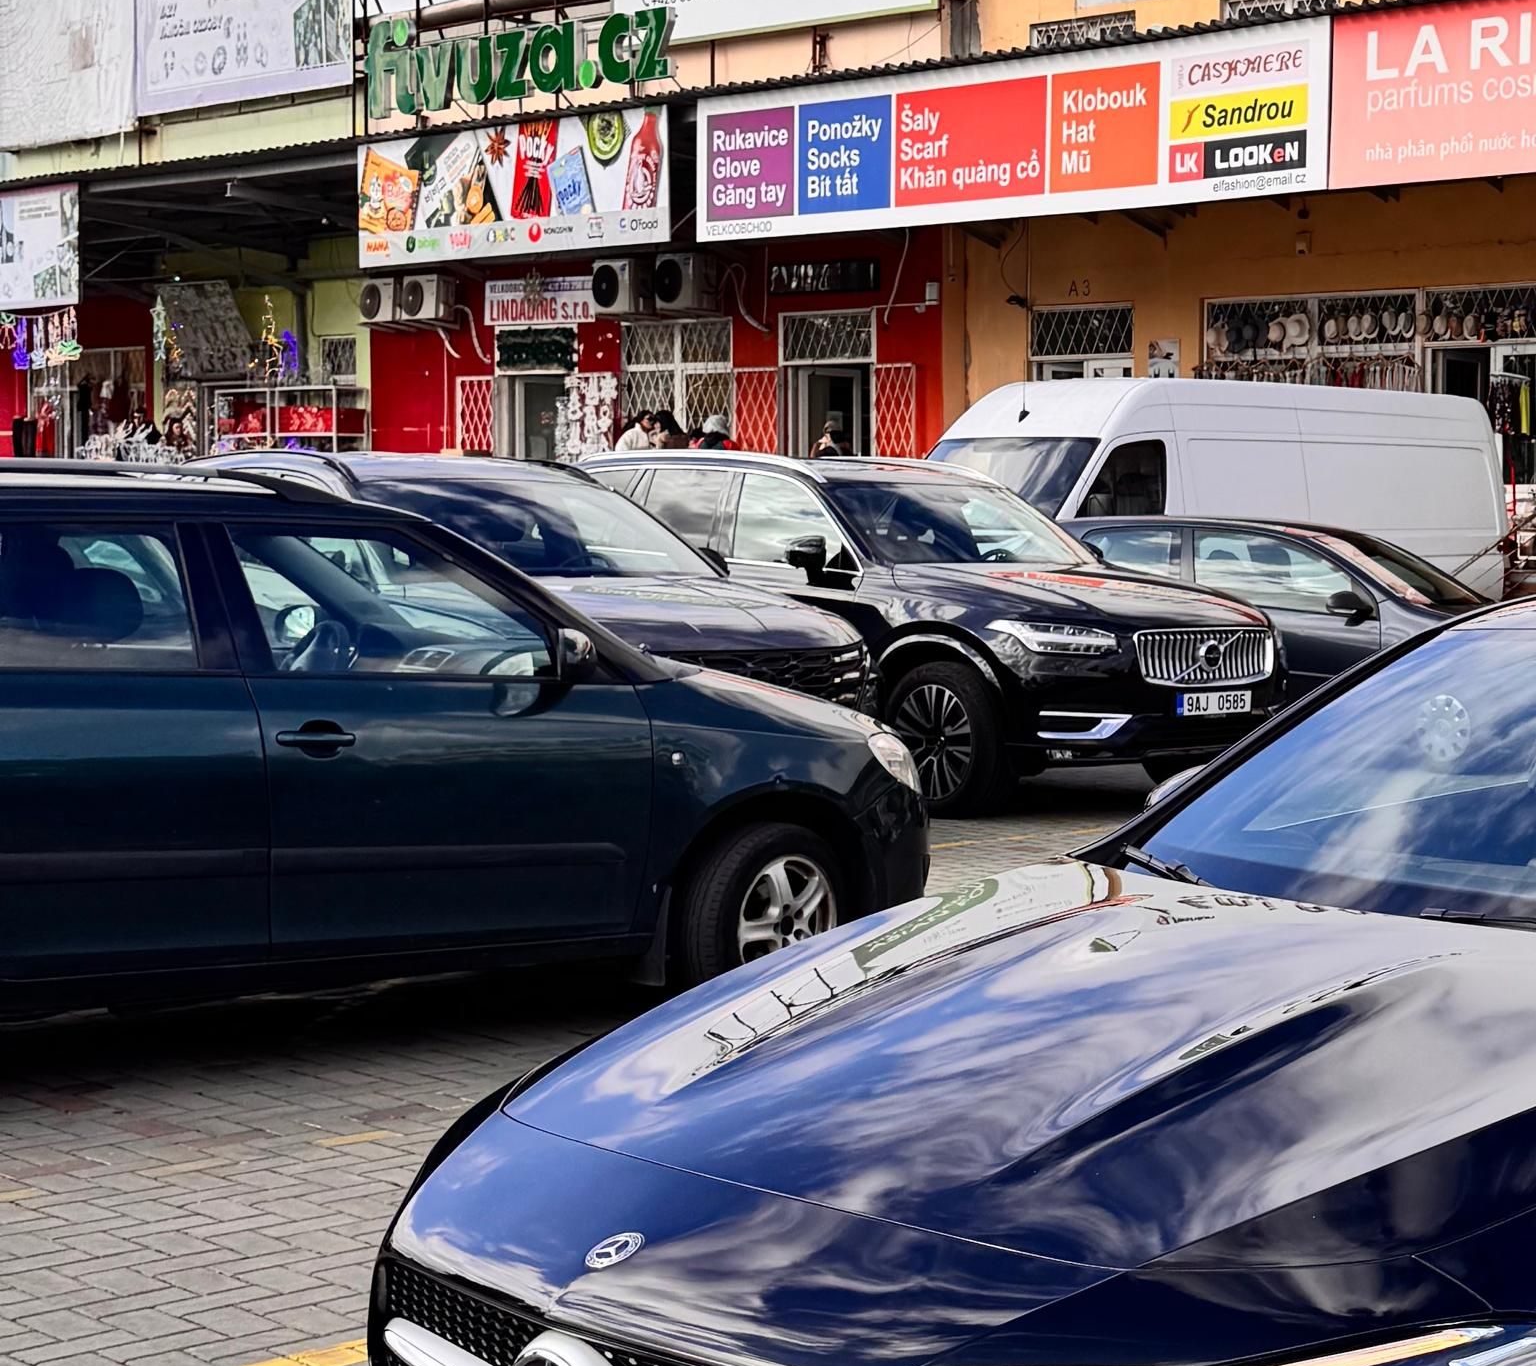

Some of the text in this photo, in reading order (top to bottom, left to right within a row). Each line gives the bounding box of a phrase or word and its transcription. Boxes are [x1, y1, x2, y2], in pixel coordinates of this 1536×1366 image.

[365, 6, 677, 120] fivuza.cz
[1365, 24, 1449, 81] LA
[1188, 49, 1302, 86] CASHMERE
[1063, 83, 1147, 115] Klobouk
[1203, 98, 1294, 128] Sandrou
[1366, 78, 1473, 119] parfums
[807, 114, 882, 143] Ponožky
[900, 103, 940, 134] Šaly
[1062, 121, 1096, 145] Hat
[519, 134, 554, 166] POCKY
[712, 125, 789, 152] Rukavice
[900, 134, 949, 162] Scarf
[1365, 140, 1393, 162] nhà
[1397, 137, 1435, 164] phân
[1478, 130, 1515, 152] nước
[712, 158, 761, 180] Glove
[807, 147, 860, 171] Socks
[900, 165, 947, 191] Khăn
[1016, 149, 1040, 179] cổ
[1061, 150, 1091, 176] Mũ
[1214, 141, 1299, 170] LOOKeN
[712, 181, 787, 209] Găng tay
[807, 169, 859, 199] Bít tất
[706, 220, 773, 236] VELKOOBCHOD
[561, 301, 594, 321] s.r.o.
[1187, 693, 1246, 713] 9AJ 0585
